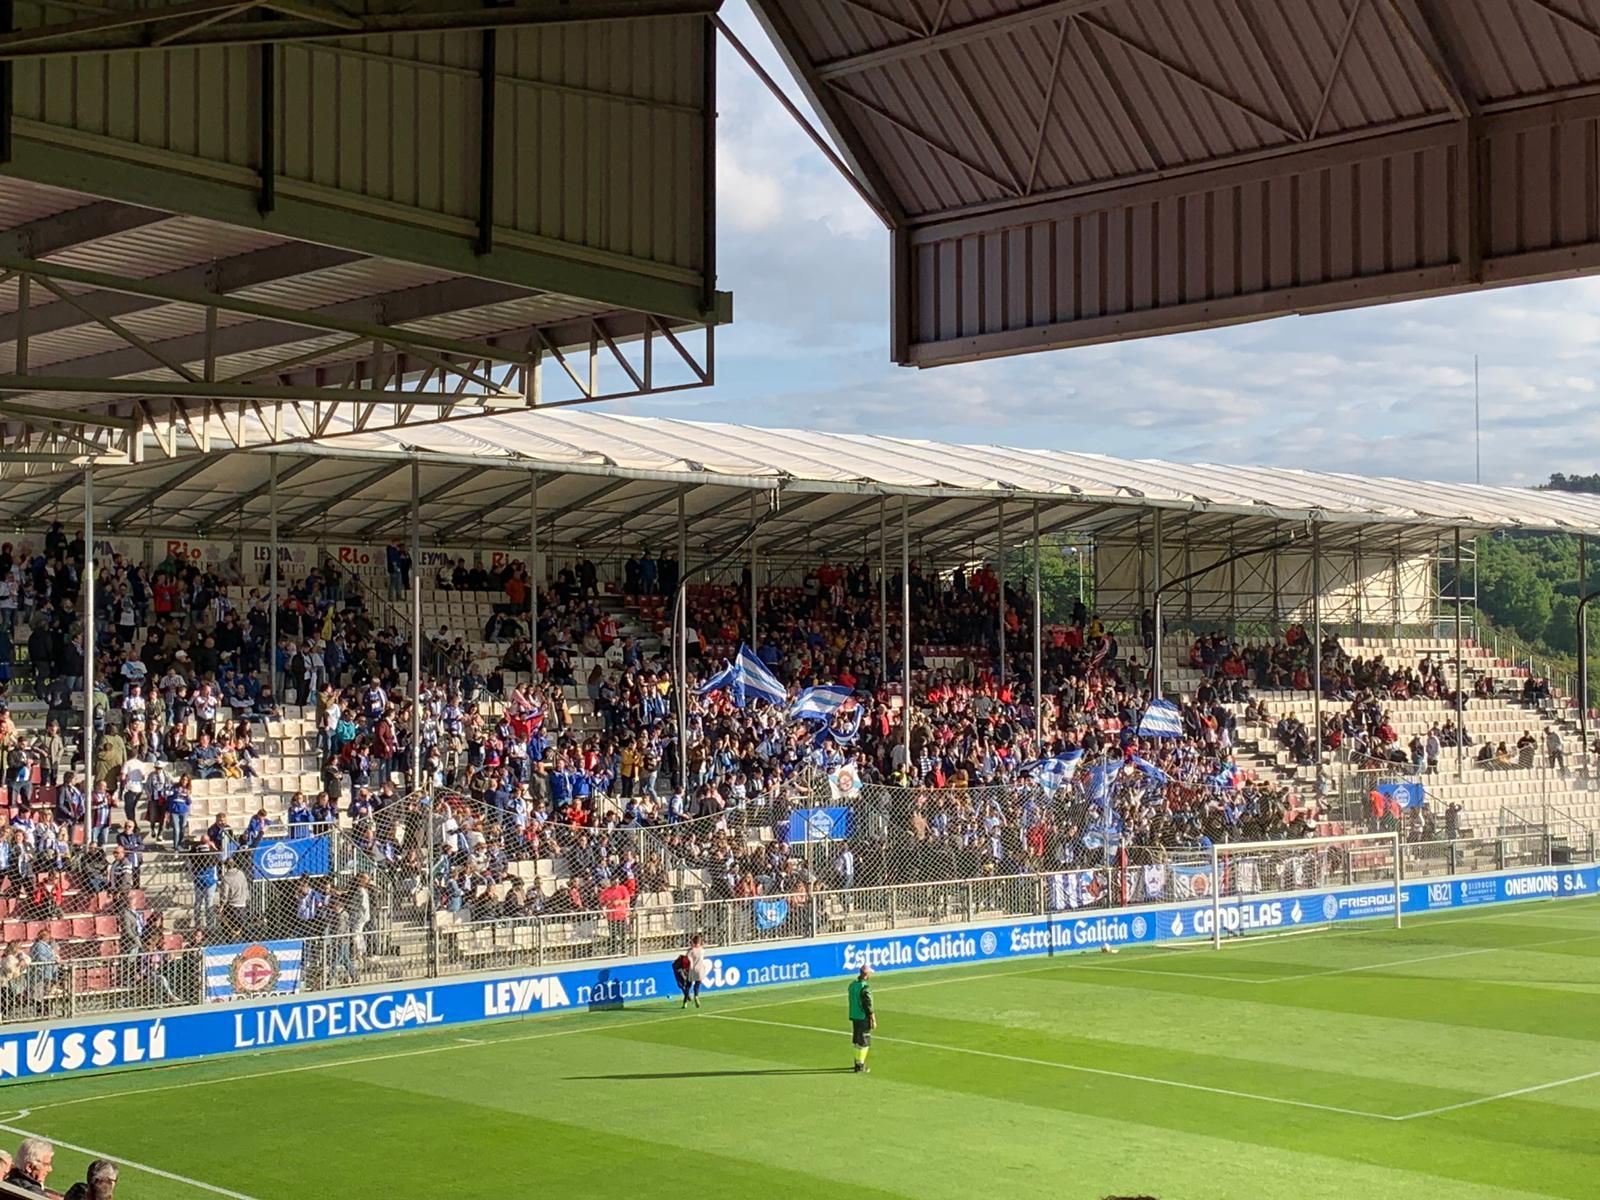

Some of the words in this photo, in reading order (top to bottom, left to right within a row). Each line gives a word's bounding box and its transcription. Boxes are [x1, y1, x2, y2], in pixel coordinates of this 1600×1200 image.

[338, 547, 370, 564] Rio
[1428, 883, 1452, 902] NB21
[1505, 875, 1558, 896] ONEMONS
[1563, 873, 1587, 891] S.A.
[1339, 892, 1410, 909] FRISAQUS
[1193, 902, 1282, 933] CANDELAS
[1010, 929, 1071, 952] Estrella
[1073, 916, 1128, 942] Galicia
[842, 942, 912, 970] Estrella
[914, 934, 976, 963] Galicia
[746, 961, 811, 985] natura
[484, 976, 571, 1016] LEYMA
[576, 976, 658, 1004] natura
[234, 991, 444, 1048] LIMPERGAL
